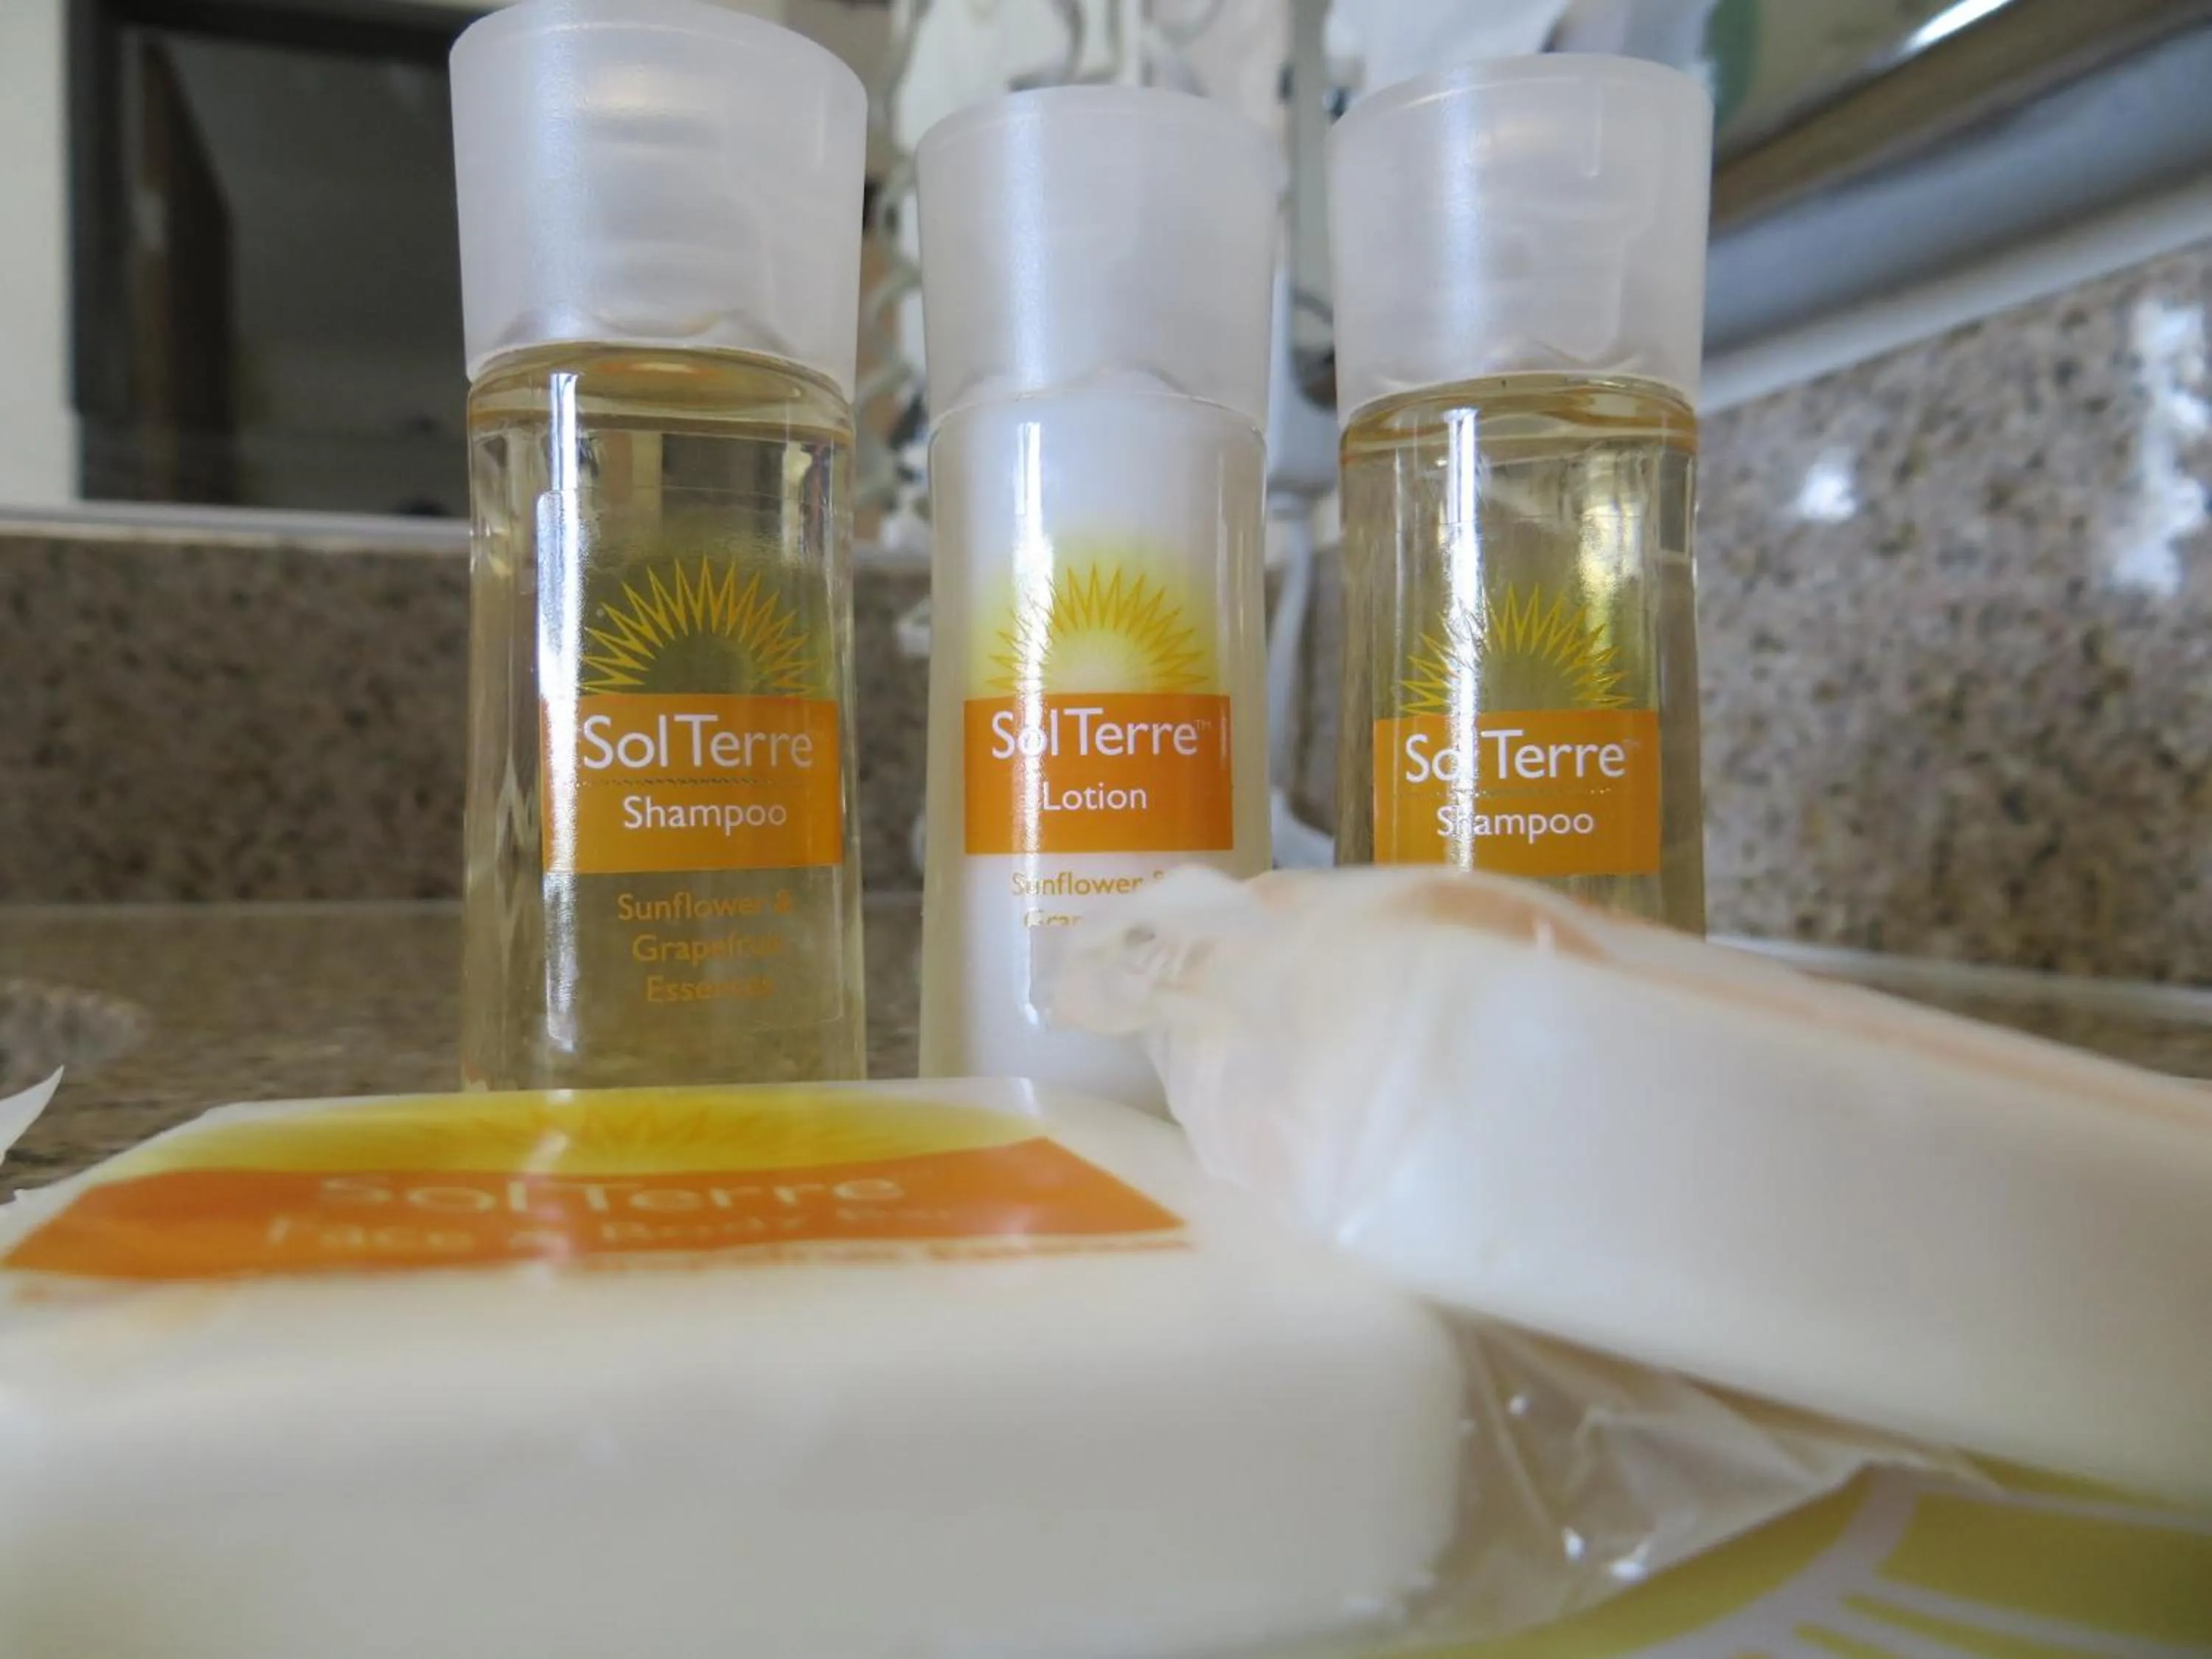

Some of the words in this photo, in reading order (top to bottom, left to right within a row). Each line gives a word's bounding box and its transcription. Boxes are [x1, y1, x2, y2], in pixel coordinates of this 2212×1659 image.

[1042, 782, 1147, 810] Lotion
[624, 796, 787, 836] Shampoo
[1436, 805, 1594, 844] Shampoo
[617, 891, 764, 921] Sunflower
